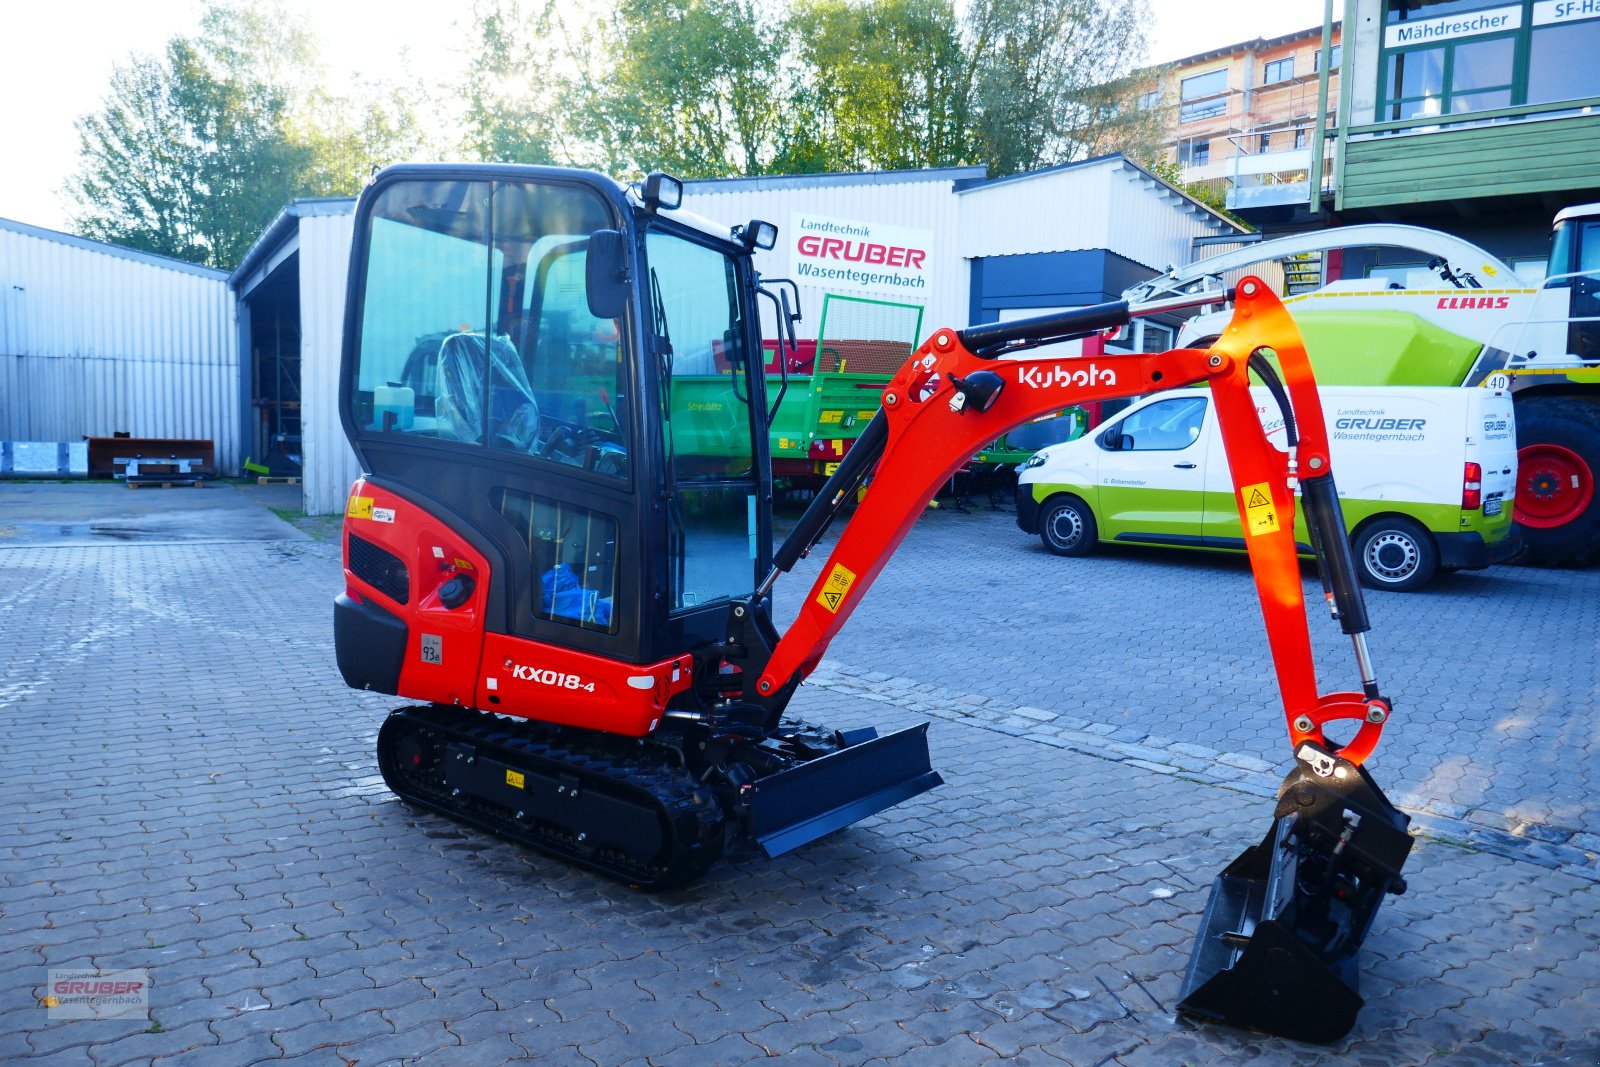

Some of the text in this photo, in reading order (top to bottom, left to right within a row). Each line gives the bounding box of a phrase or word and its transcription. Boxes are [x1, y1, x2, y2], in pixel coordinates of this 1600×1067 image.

[1398, 14, 1509, 41] Mähdrescher
[800, 218, 871, 237] Landtechnik
[797, 235, 926, 270] GRUBER
[797, 263, 925, 288] Wasentegernbach
[1437, 297, 1509, 309] CLAAS
[1018, 363, 1116, 388] Kubota
[1490, 376, 1505, 389] 40
[1337, 408, 1386, 416] Landtechnik
[1335, 418, 1427, 431] GRUBER
[1333, 431, 1425, 442] Wasentegernbach
[512, 664, 595, 693] KX018-4
